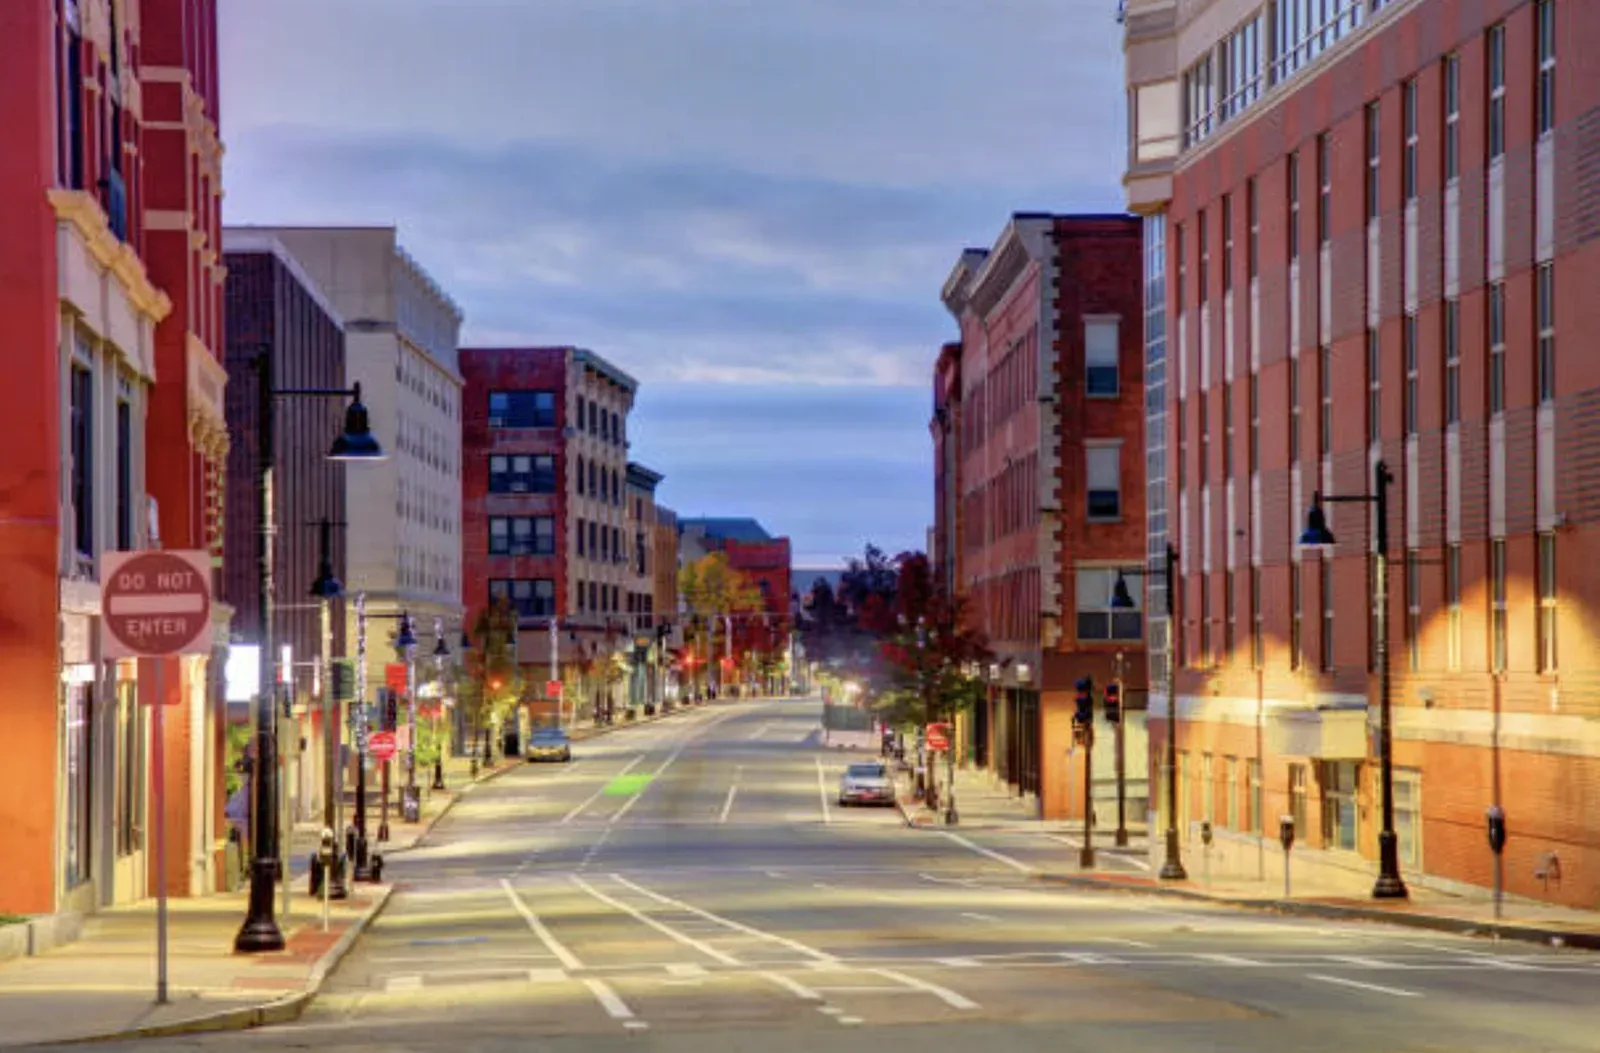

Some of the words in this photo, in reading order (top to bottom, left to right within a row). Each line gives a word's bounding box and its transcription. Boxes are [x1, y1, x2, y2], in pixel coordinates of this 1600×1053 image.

[119, 573, 146, 590] DO
[157, 572, 194, 590] NOT
[126, 617, 187, 636] ENTER
